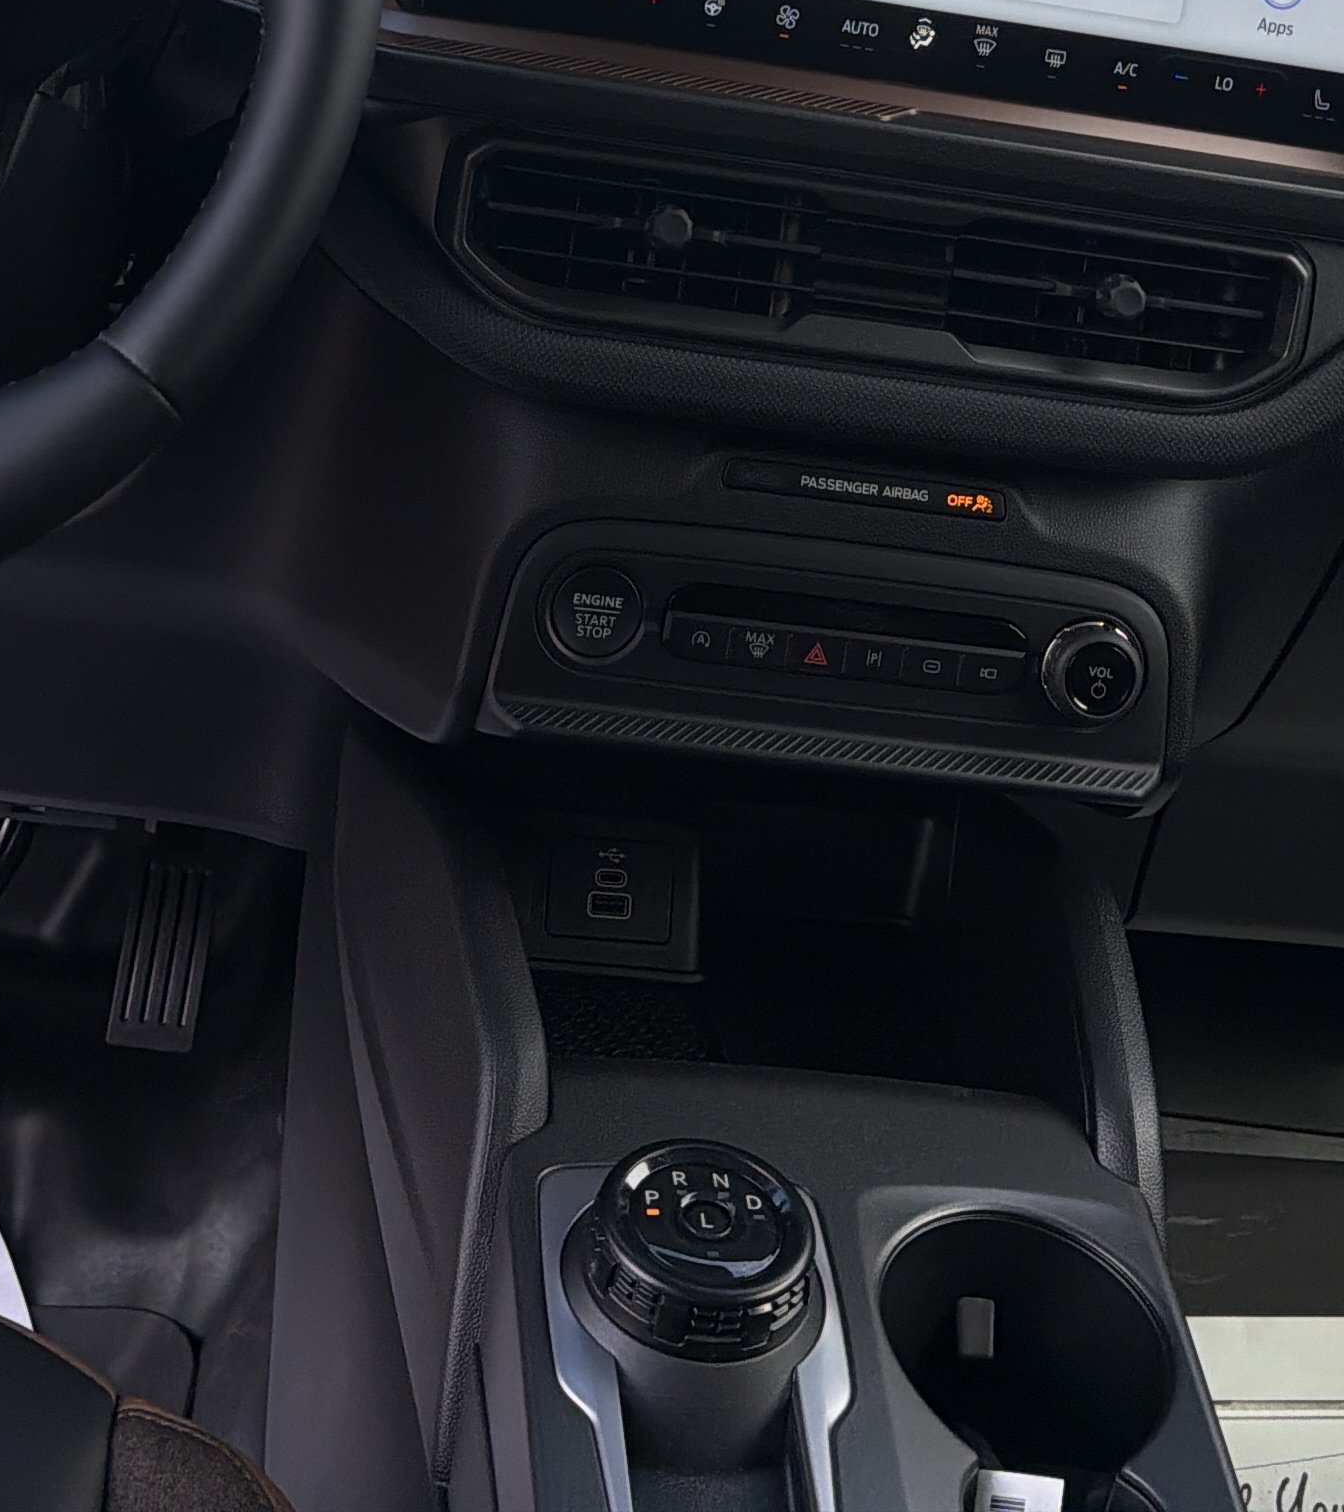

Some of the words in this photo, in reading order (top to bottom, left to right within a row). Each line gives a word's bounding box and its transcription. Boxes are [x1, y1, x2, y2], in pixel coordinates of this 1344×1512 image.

[841, 18, 880, 38] AUTO
[975, 24, 999, 38] MAX
[1257, 17, 1294, 37] Apps
[1113, 61, 1138, 78] A/C
[1214, 76, 1234, 92] LO
[800, 475, 879, 495] PASSENGER
[881, 485, 929, 502] AIRBAG
[947, 493, 973, 507] OFF
[572, 593, 624, 609] ENGINE
[574, 613, 617, 629] START
[576, 624, 613, 638] STOP
[745, 631, 775, 645] MAX
[1089, 666, 1113, 680] VOL
[672, 1171, 688, 1186] R
[712, 1172, 729, 1188] N
[644, 1190, 659, 1205] P
[746, 1194, 762, 1210] D
[700, 1212, 714, 1228] L
